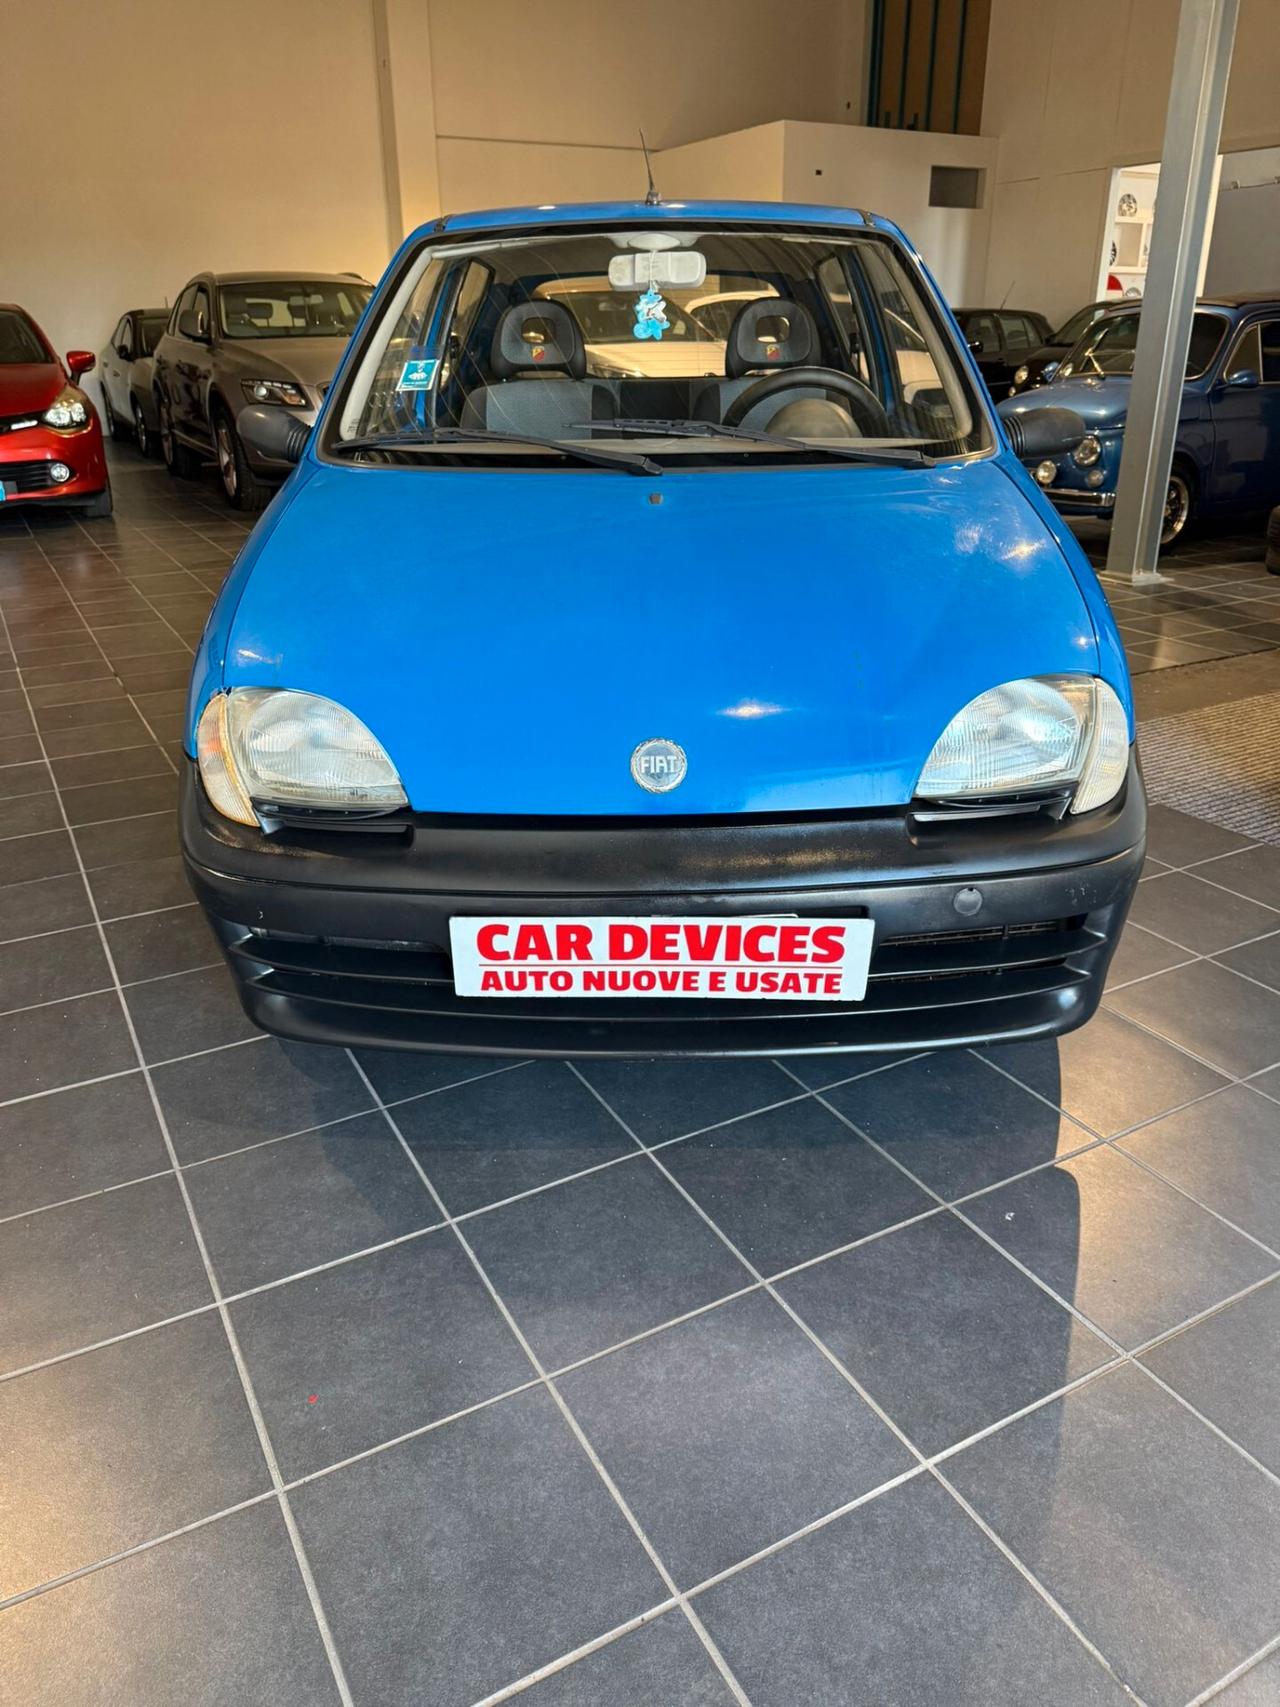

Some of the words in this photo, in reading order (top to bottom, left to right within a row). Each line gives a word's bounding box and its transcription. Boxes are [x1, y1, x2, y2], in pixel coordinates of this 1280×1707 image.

[640, 755, 677, 774] FIAT
[476, 923, 593, 962] CAR
[607, 923, 846, 964] DEVICES
[480, 970, 574, 992] AUTO
[582, 970, 700, 993] NUOVE
[708, 970, 726, 993] E
[735, 971, 842, 995] USATE
